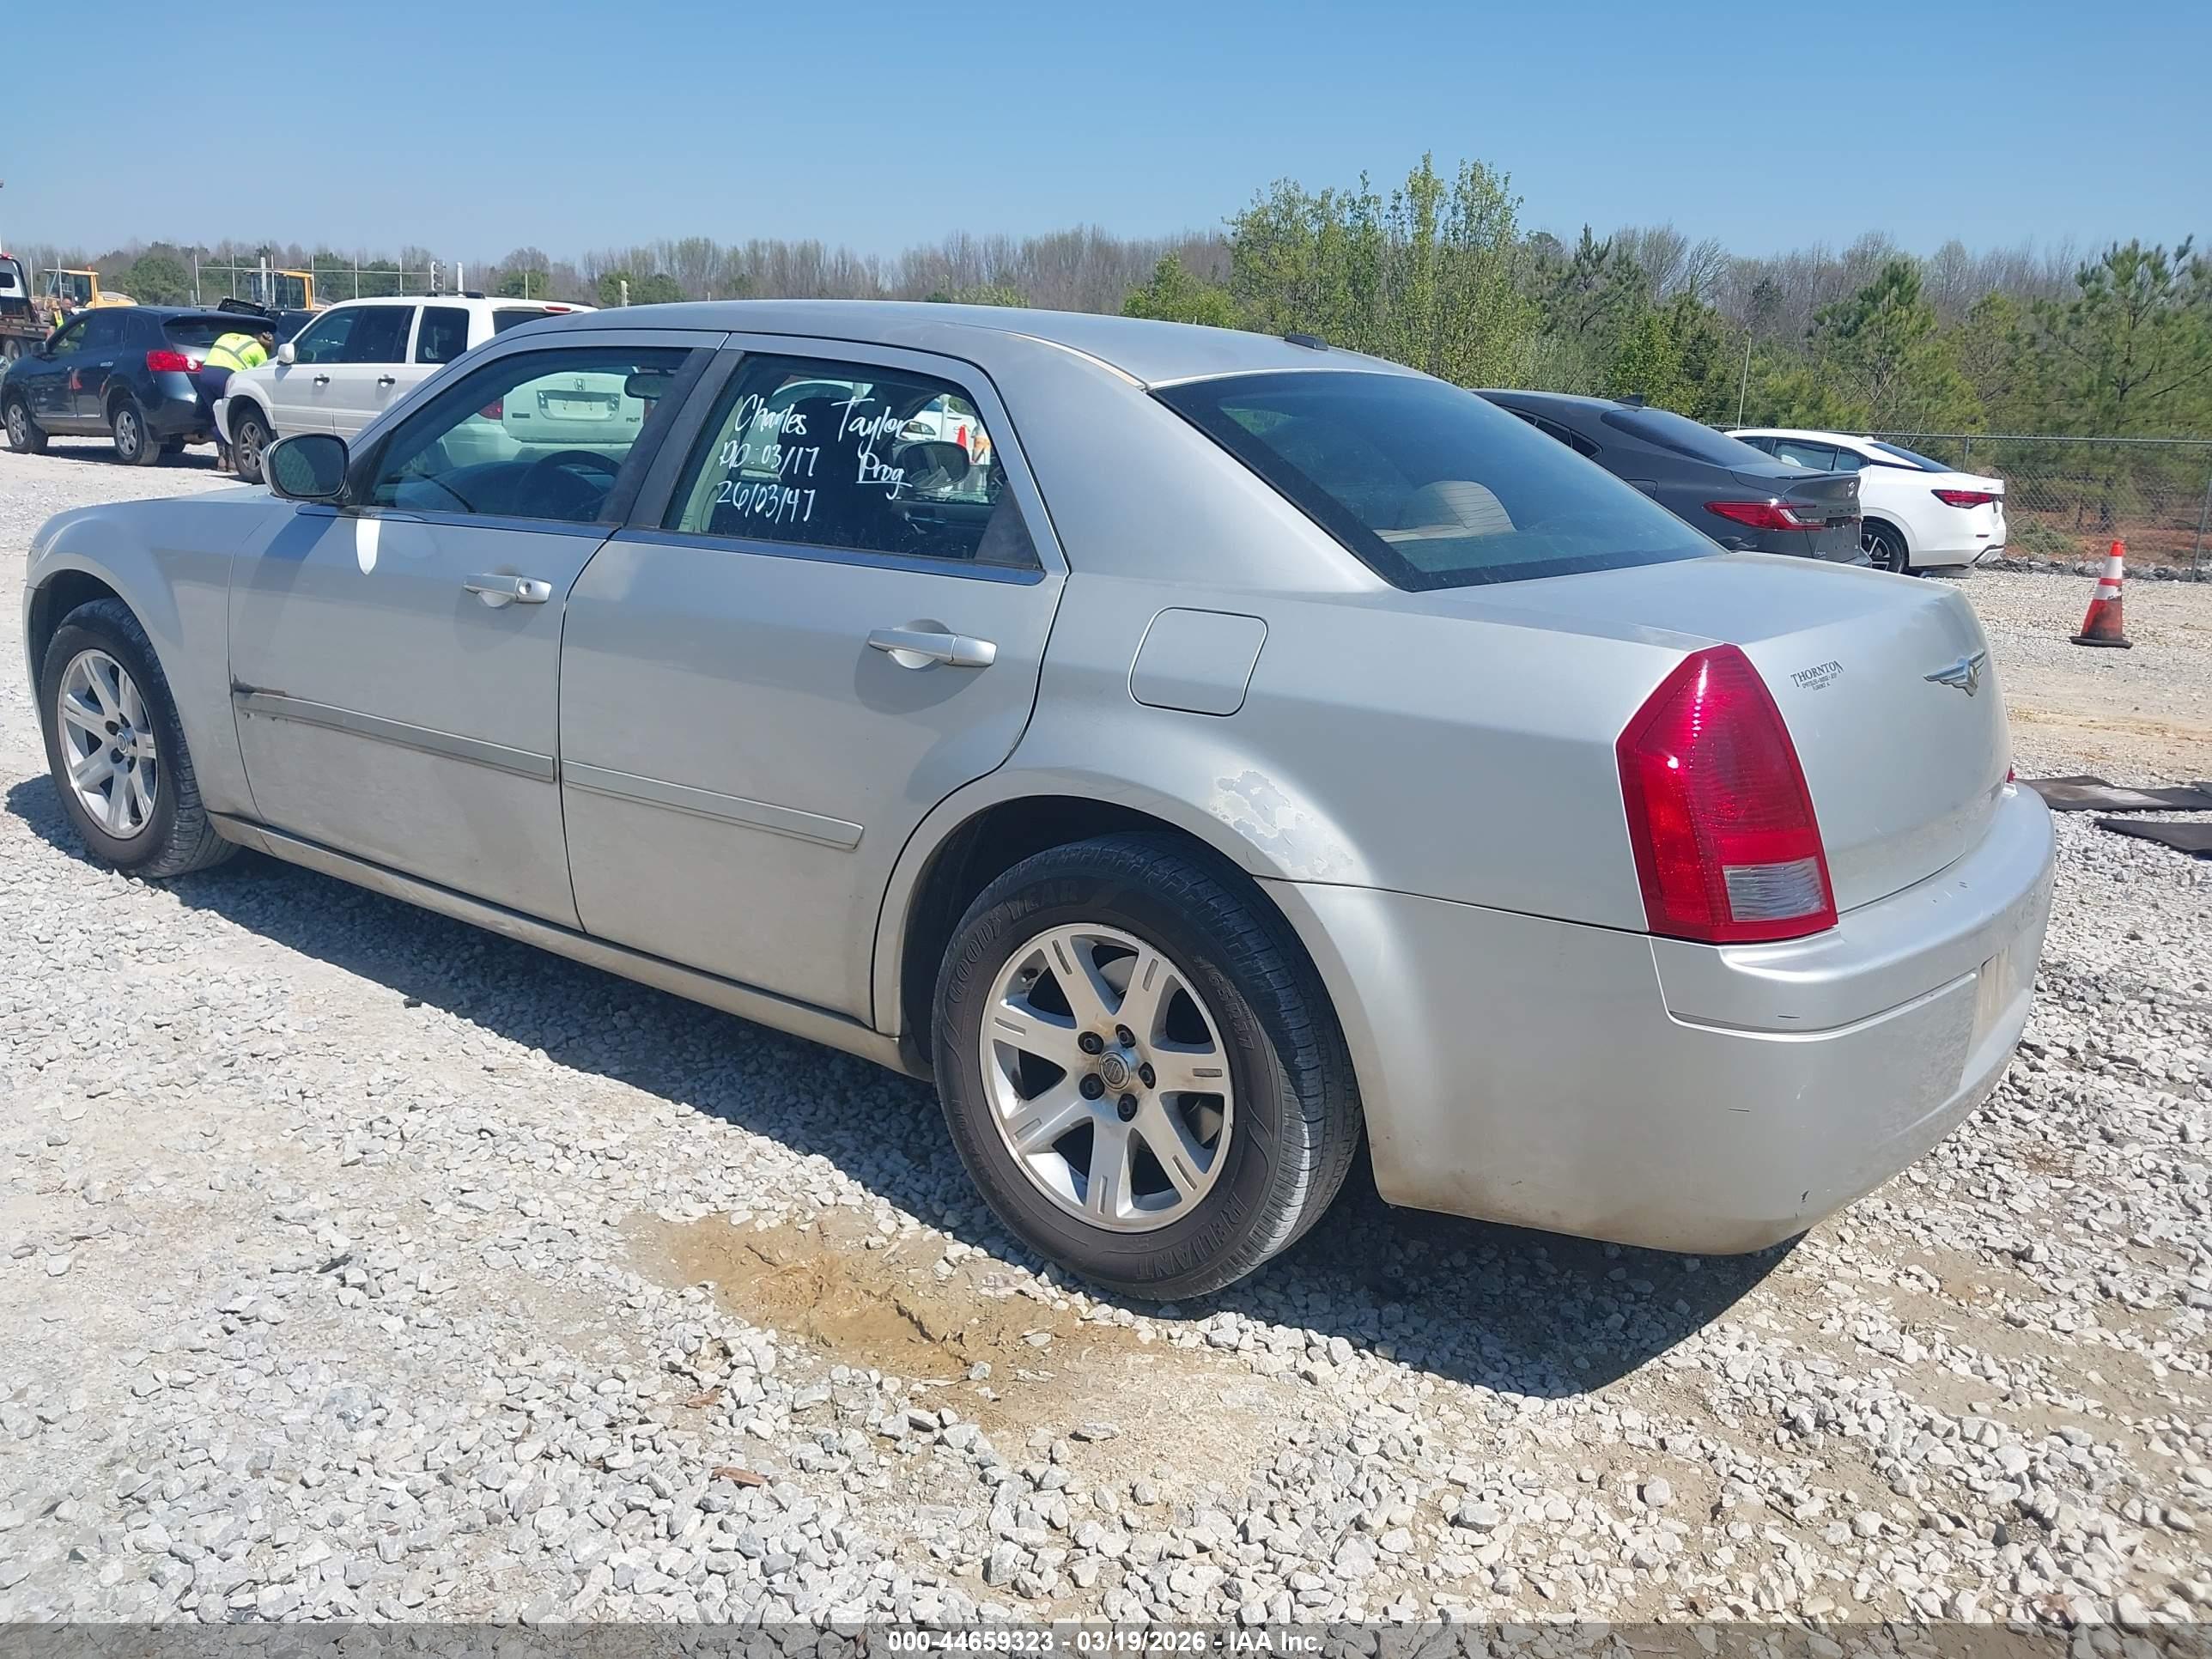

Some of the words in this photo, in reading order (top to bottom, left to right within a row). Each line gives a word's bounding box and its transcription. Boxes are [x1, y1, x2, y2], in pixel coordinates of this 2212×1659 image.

[734, 393, 807, 435] Charles
[830, 396, 915, 459] Taylor
[855, 452, 913, 500] Prog
[1790, 660, 1844, 688] THORNTON
[1134, 1191, 1249, 1280] RELIANT
